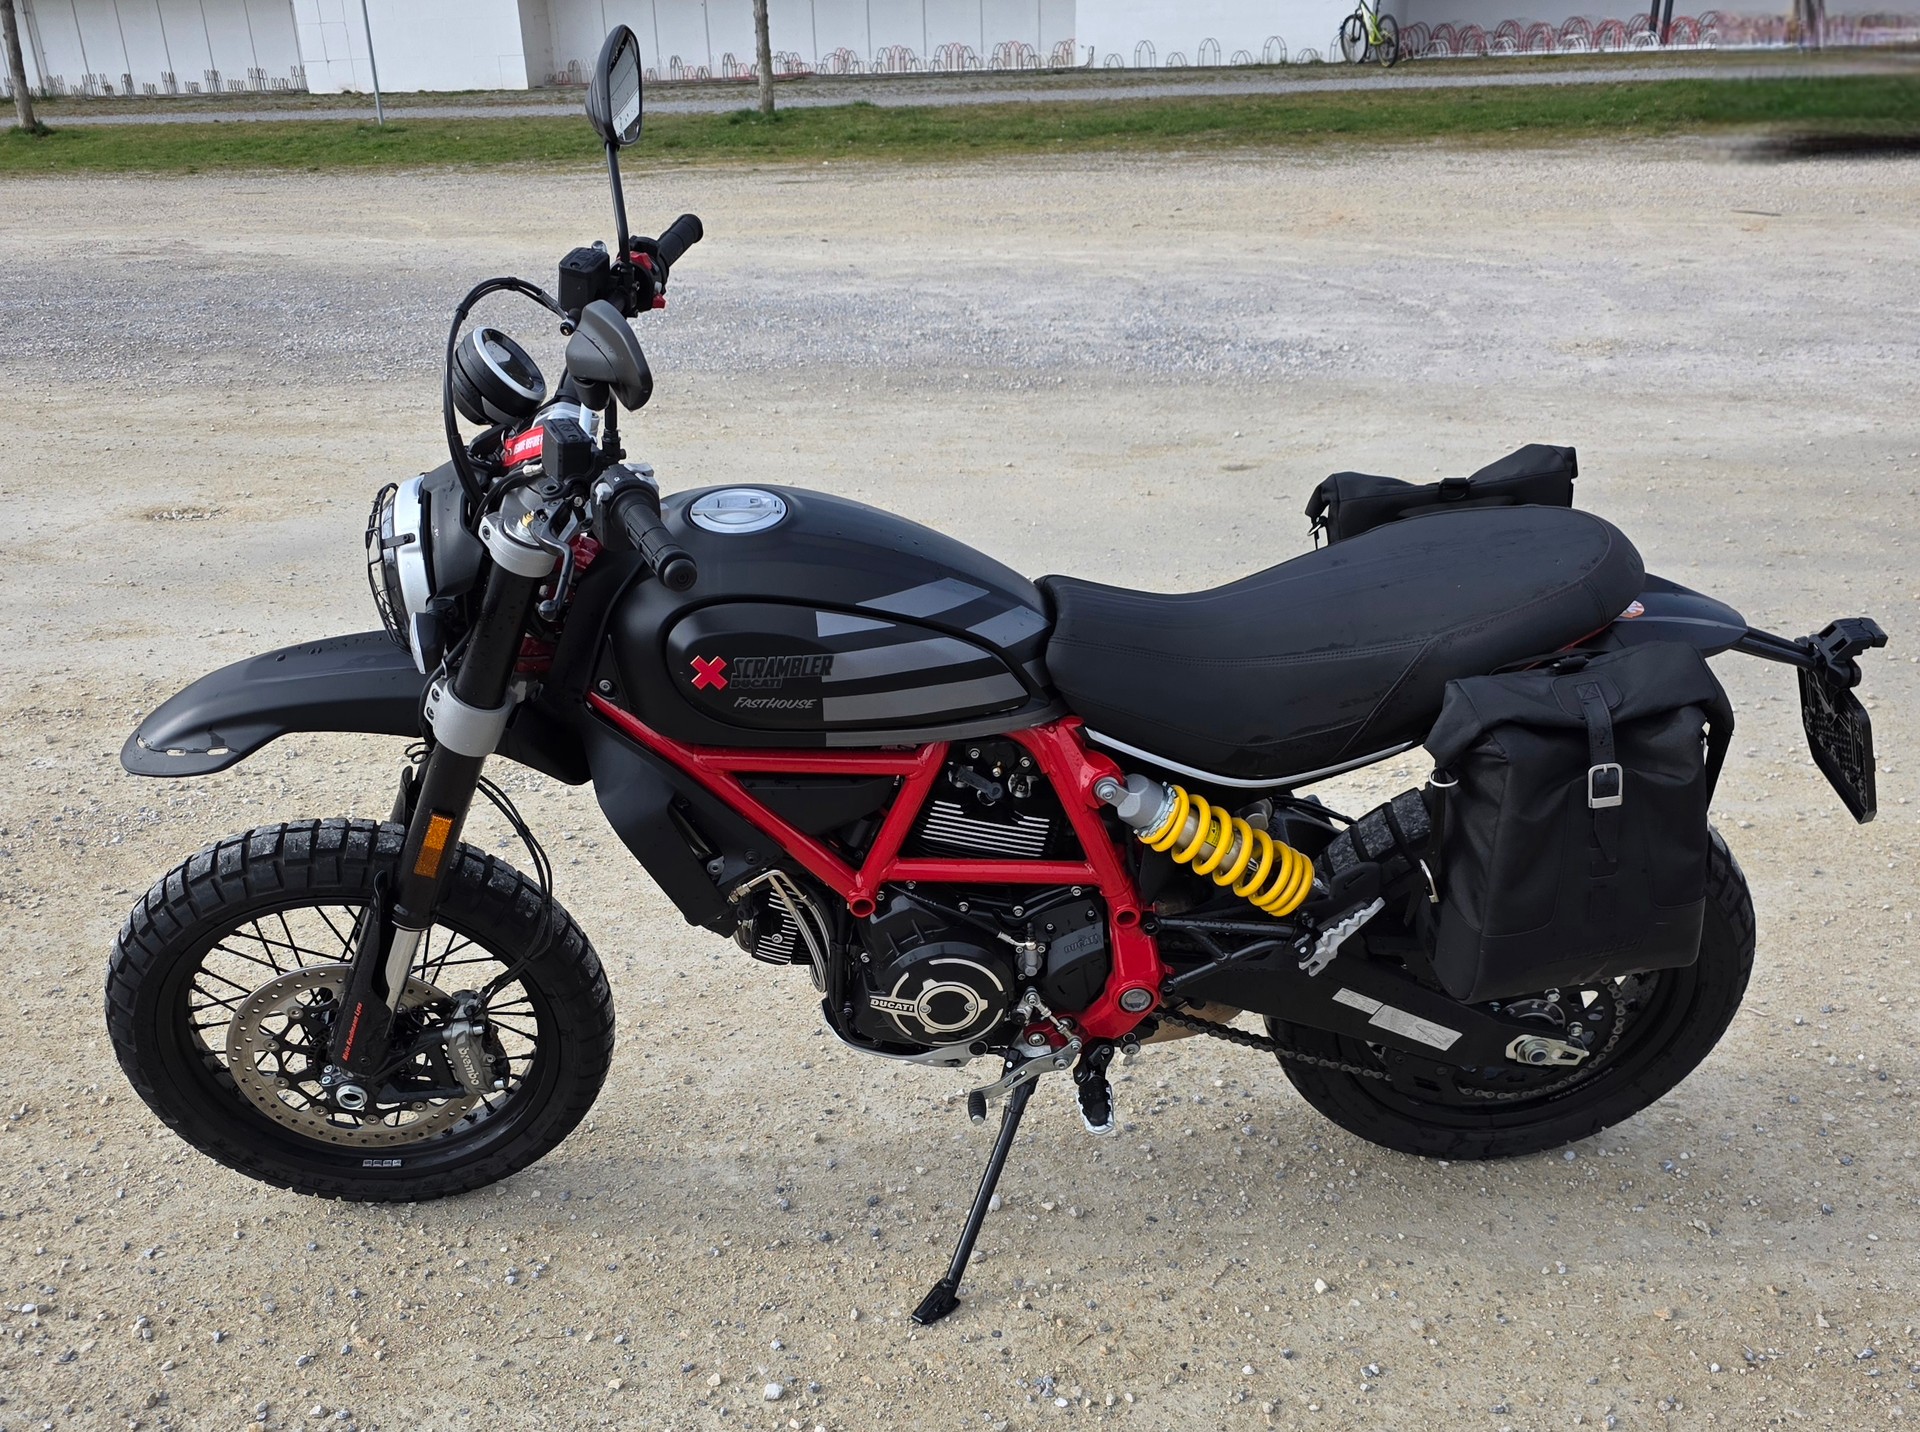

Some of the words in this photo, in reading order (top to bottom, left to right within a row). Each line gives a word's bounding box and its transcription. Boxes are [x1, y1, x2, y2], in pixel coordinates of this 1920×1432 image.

[731, 656, 834, 678] SCRAMBLER
[731, 678, 783, 689] DUCATI
[870, 998, 914, 1012] DUCATI
[457, 1046, 481, 1086] brembo
